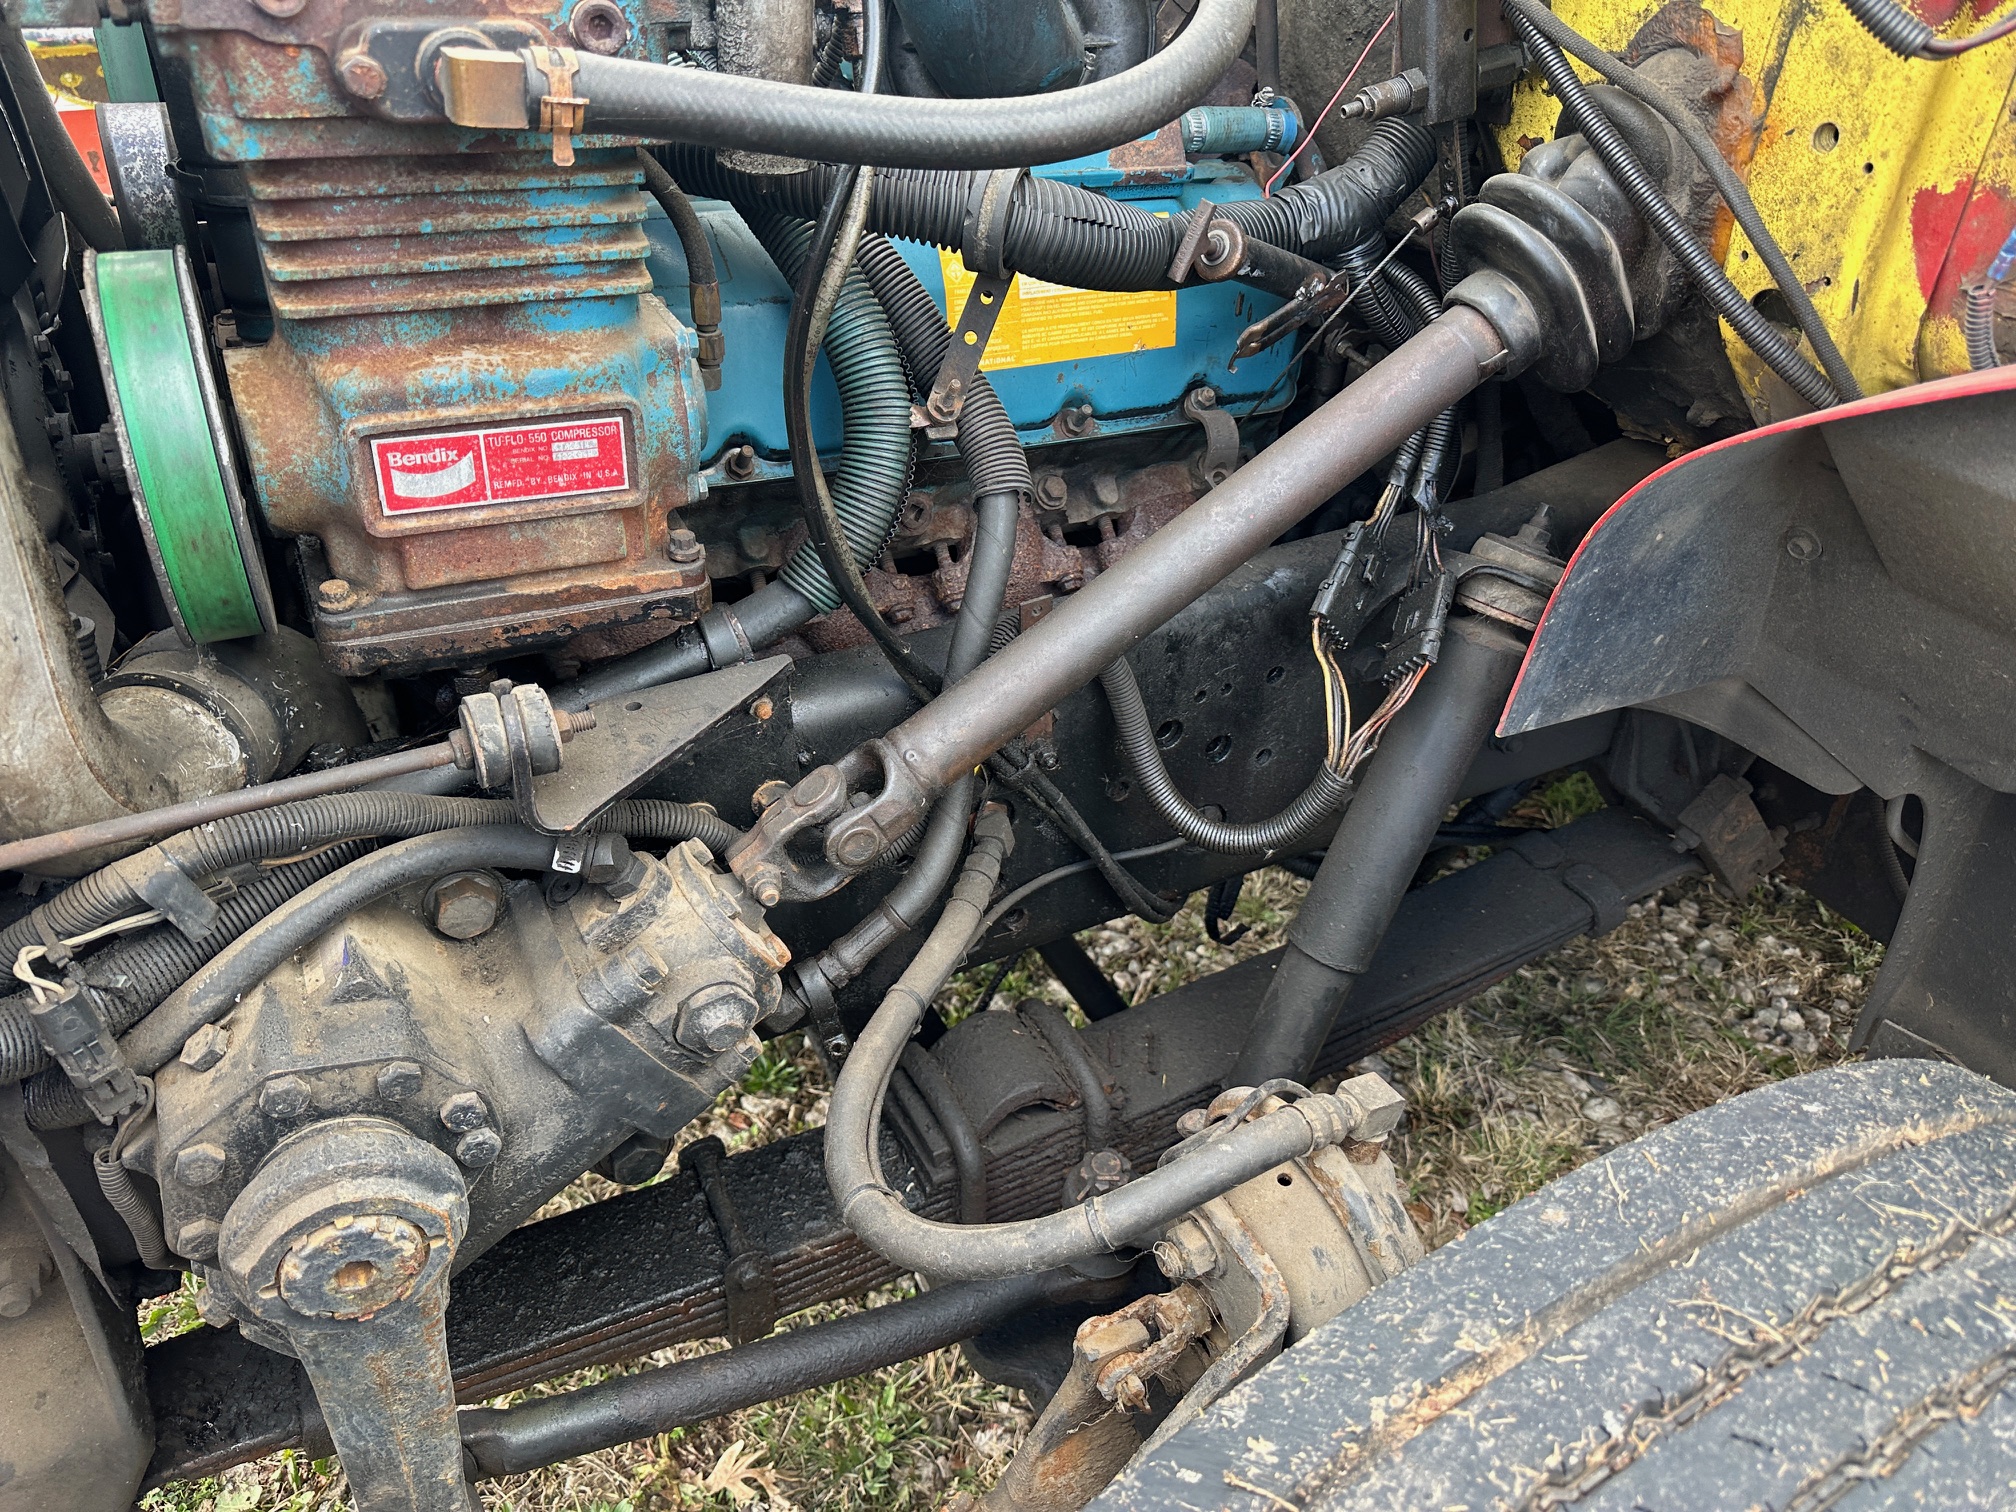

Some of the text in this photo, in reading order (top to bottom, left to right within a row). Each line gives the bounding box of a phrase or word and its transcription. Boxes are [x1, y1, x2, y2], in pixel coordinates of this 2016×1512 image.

[529, 432, 547, 444] 550
[551, 425, 618, 442] COMPRESSOR
[387, 447, 459, 467] Bendix
[529, 476, 541, 484] BY
[547, 472, 577, 482] BENDIX
[582, 470, 591, 478] IN
